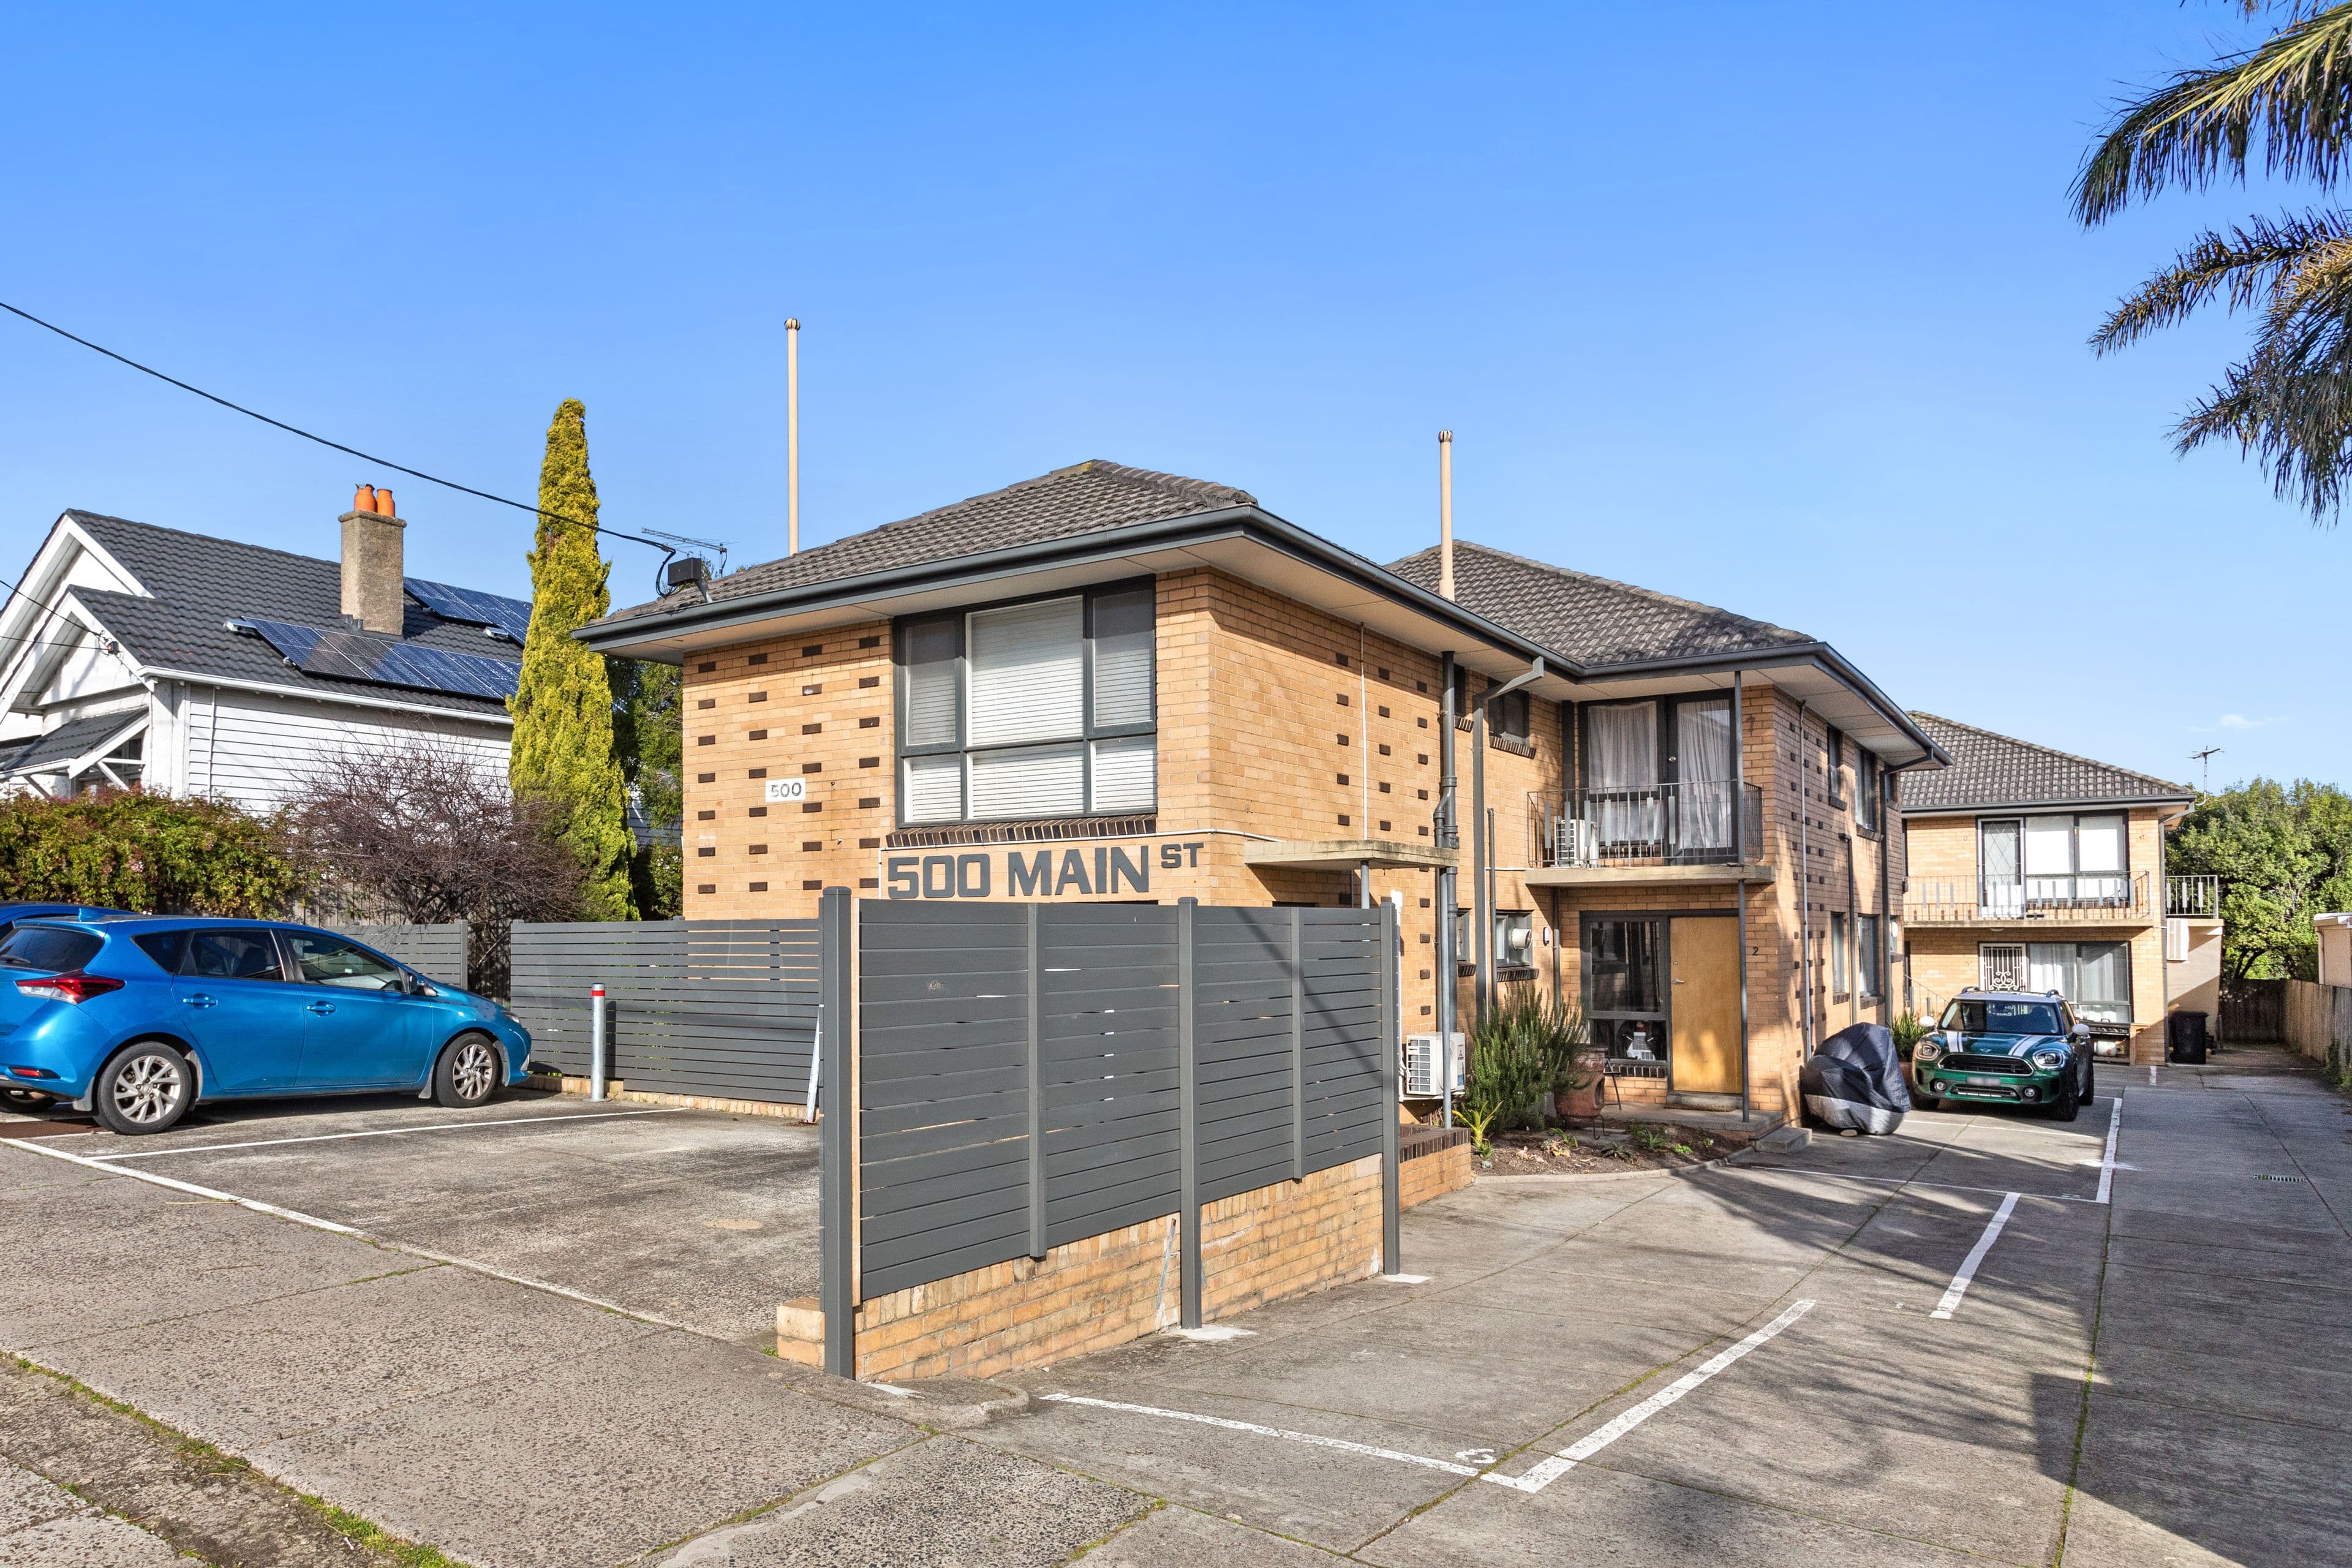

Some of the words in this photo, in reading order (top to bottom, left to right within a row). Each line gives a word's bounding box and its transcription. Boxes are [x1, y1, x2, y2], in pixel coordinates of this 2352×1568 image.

[771, 782, 802, 797] 500
[887, 853, 990, 899] 500
[1008, 845, 1150, 897] MAIN
[1161, 842, 1204, 869] ST
[1752, 946, 1758, 956] 2
